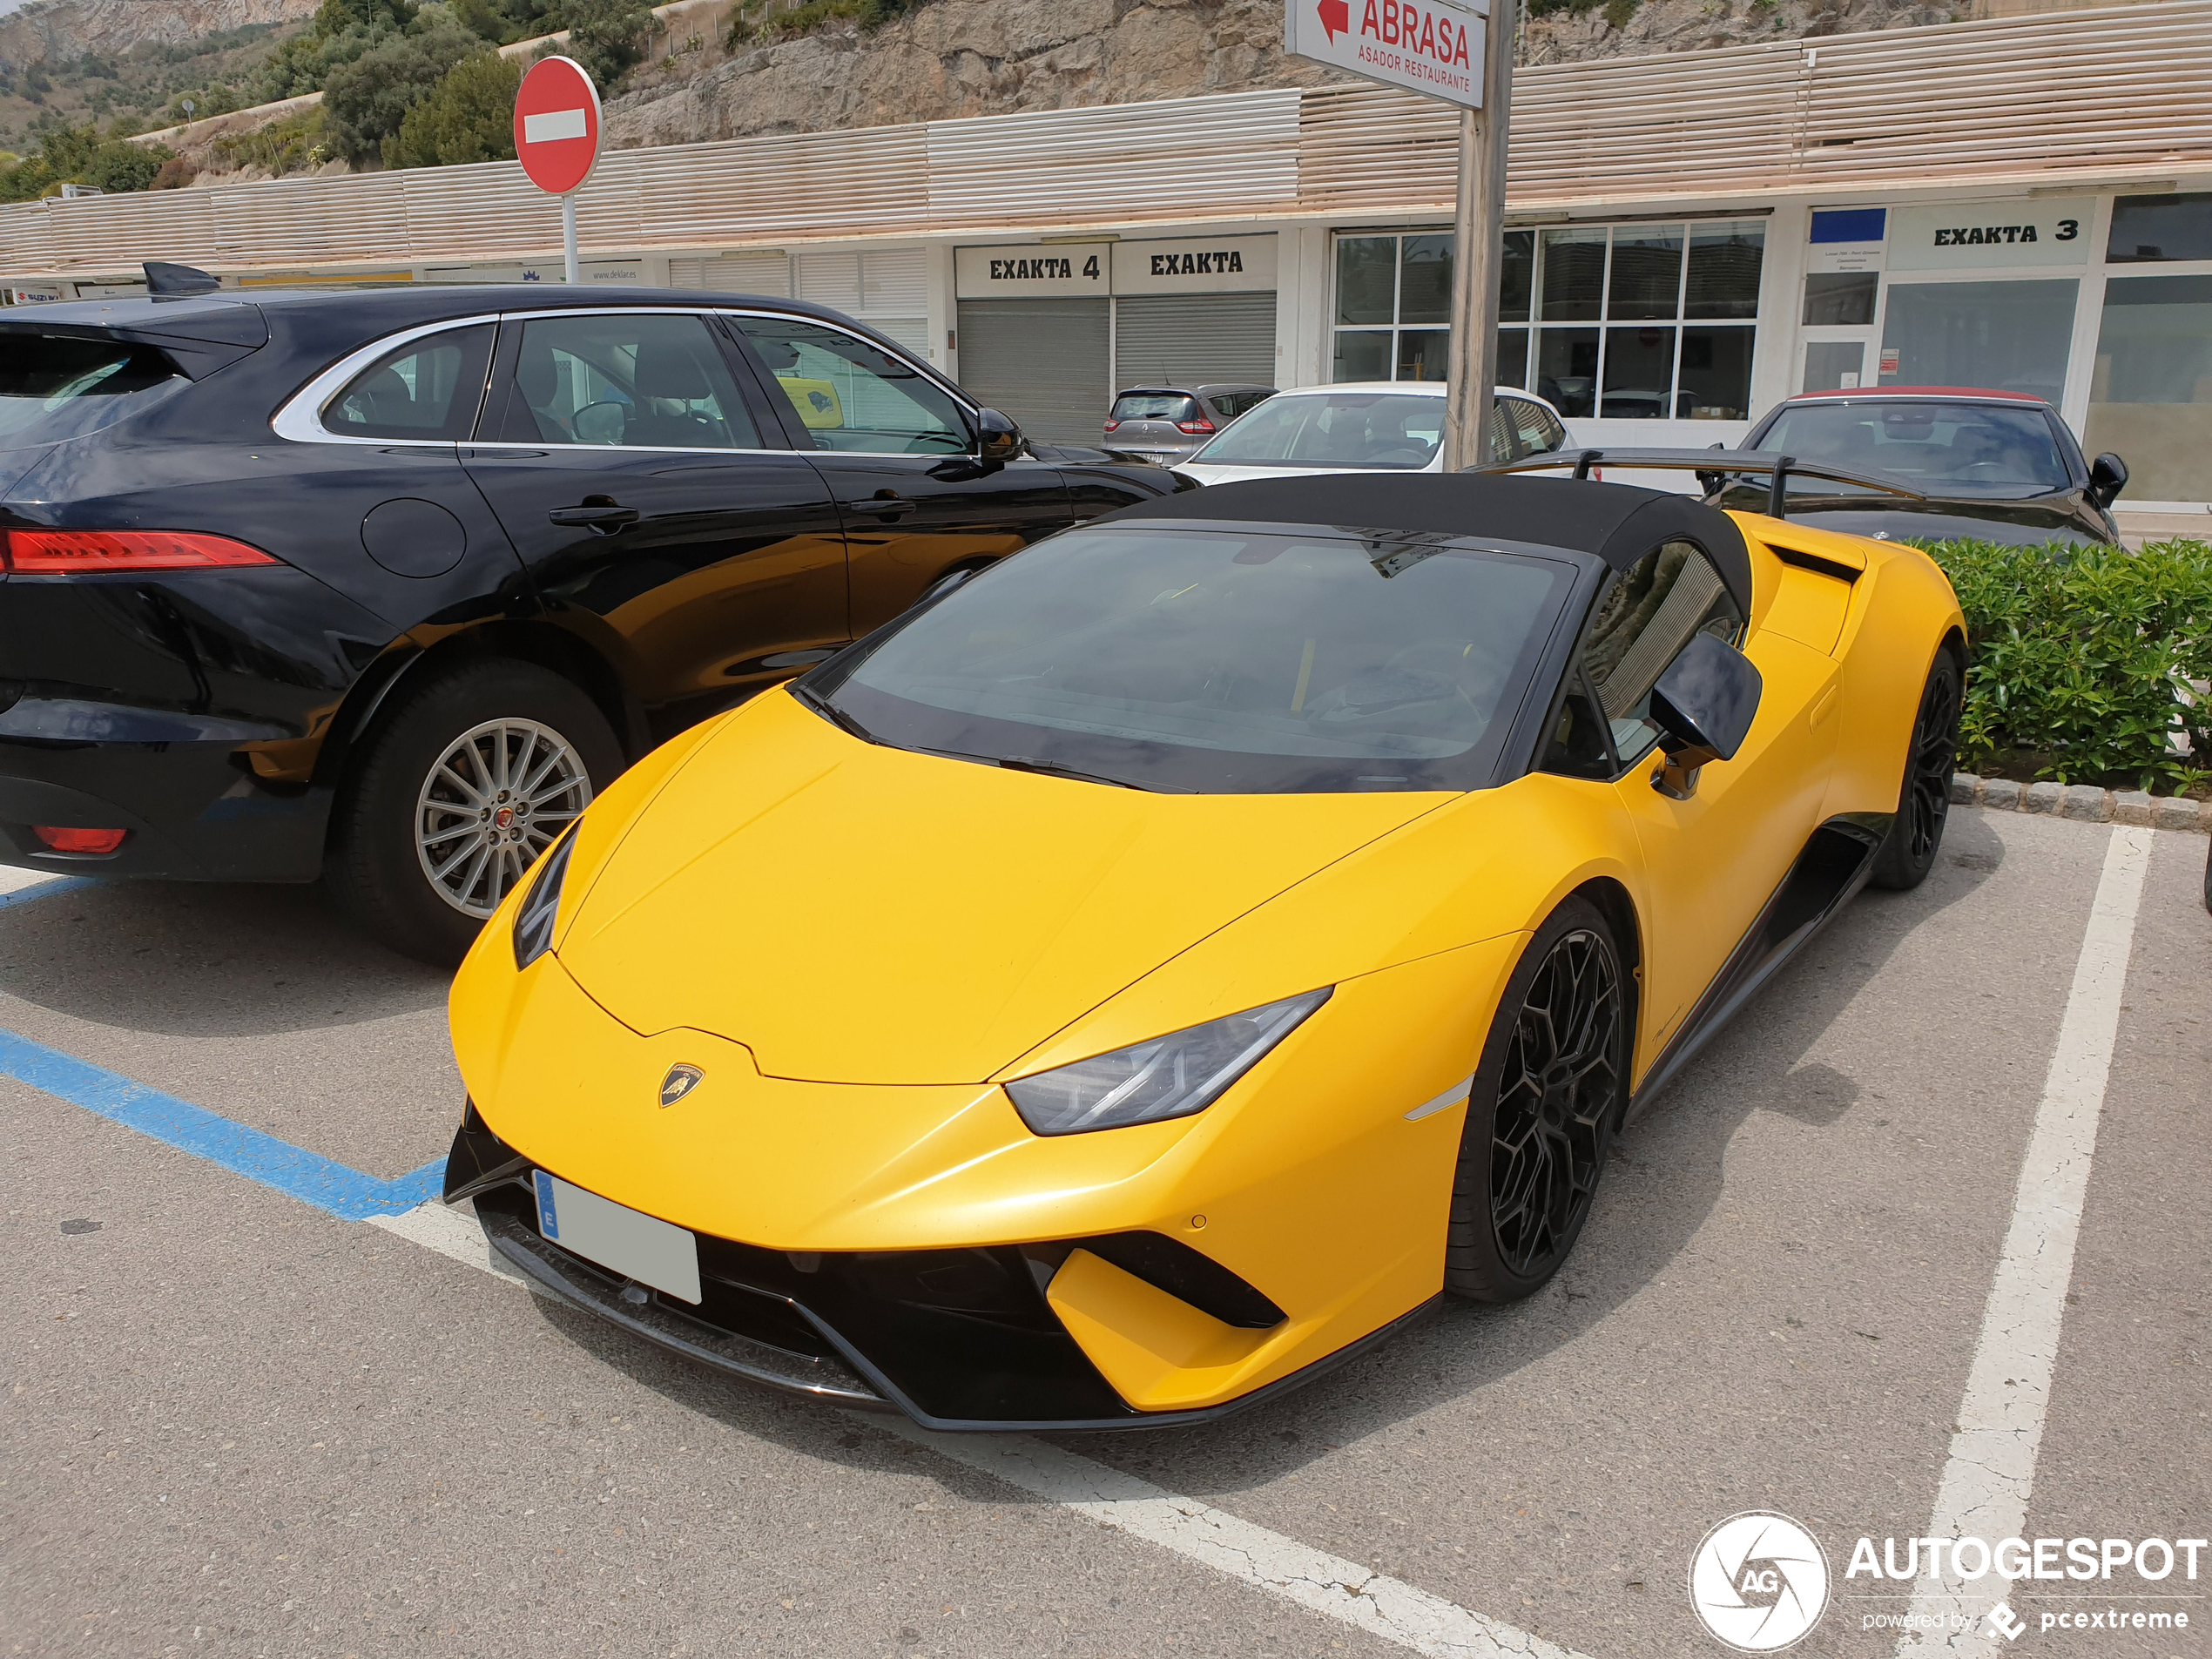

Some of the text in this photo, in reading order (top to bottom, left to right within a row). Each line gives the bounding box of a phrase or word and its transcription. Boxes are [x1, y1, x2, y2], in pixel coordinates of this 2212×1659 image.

[1360, 0, 1470, 71] ABRASA
[1358, 44, 1470, 92] ASADOR RESTAURANTE
[1934, 219, 2079, 246] EXAKTA 3
[593, 270, 637, 280] www.deklar.es
[990, 254, 1101, 280] EXAKTA 4
[1150, 251, 1244, 276] EXAKTA
[544, 1211, 555, 1228] E
